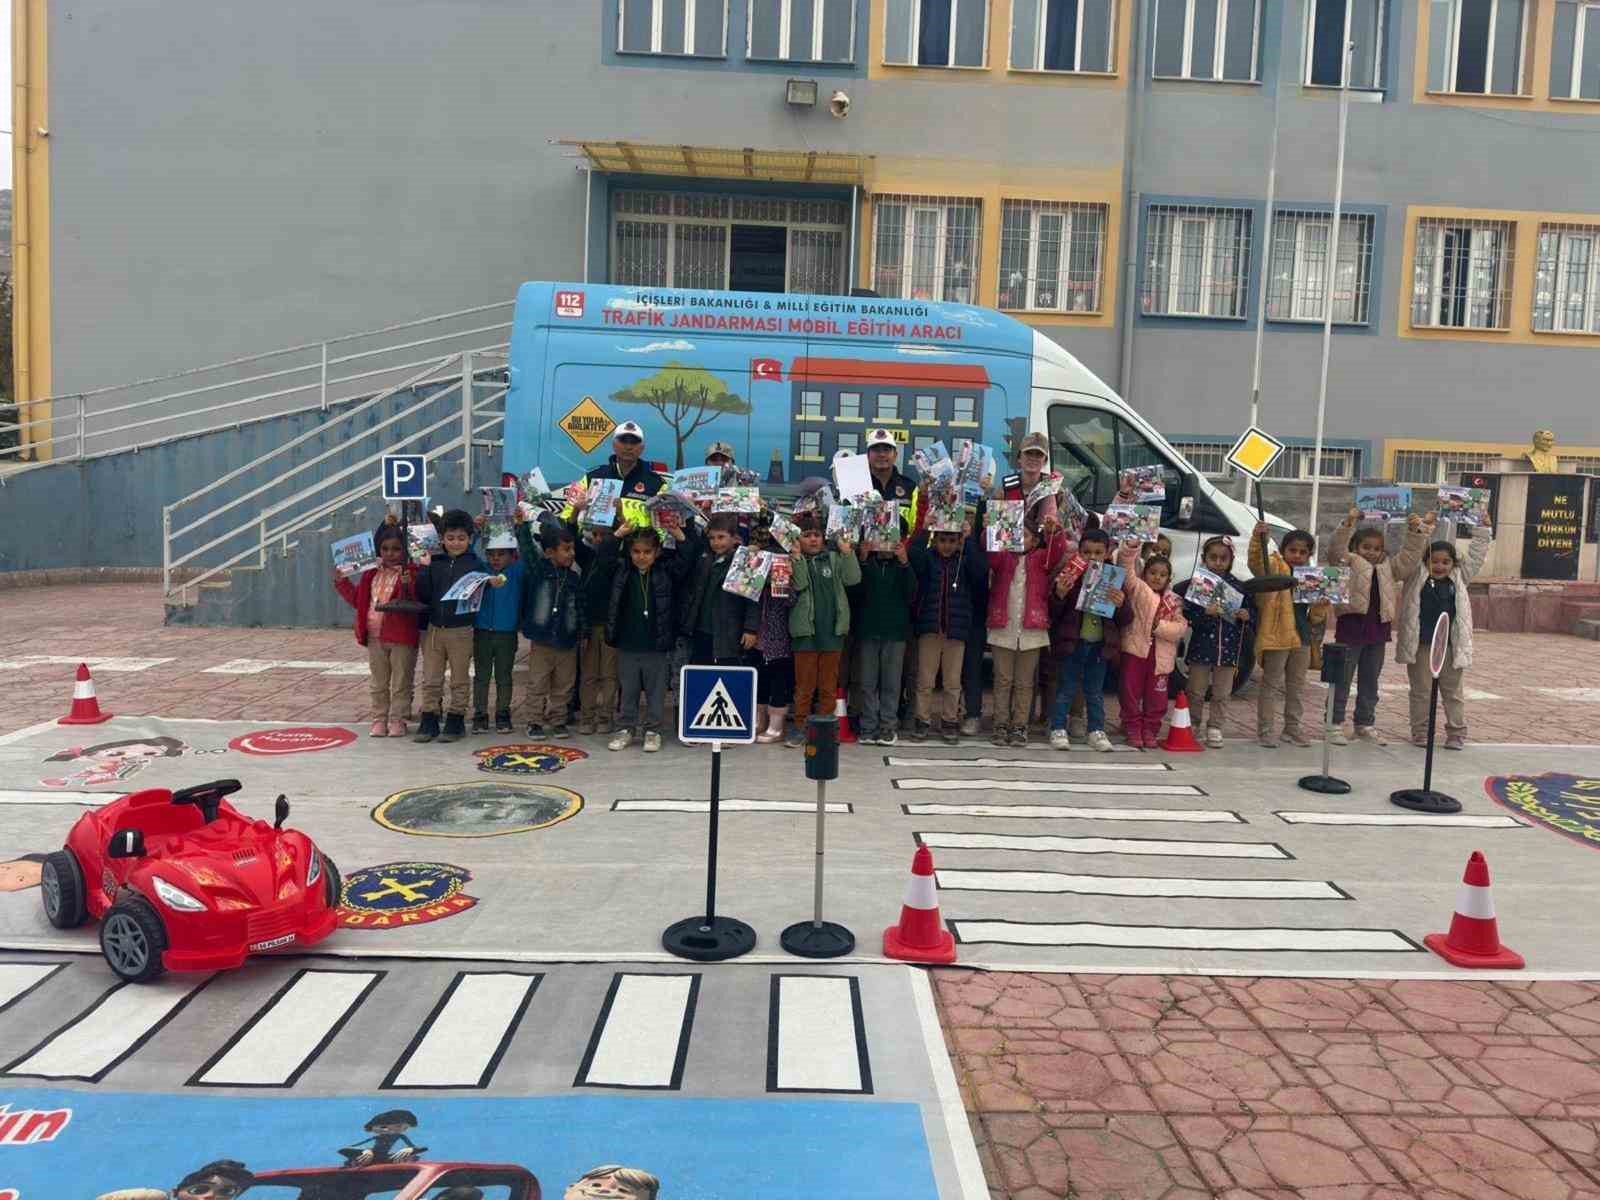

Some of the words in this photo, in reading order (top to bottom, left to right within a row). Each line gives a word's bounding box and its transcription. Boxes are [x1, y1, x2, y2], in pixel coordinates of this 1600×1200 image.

[560, 293, 580, 306] 112
[690, 296, 759, 310] BAKANLIĞI
[763, 301, 771, 310] &
[813, 302, 857, 314] EĞİTİM
[861, 305, 928, 317] BAKANLIĞI
[603, 308, 665, 327] TRAFİK
[672, 313, 782, 332] JANDARMASI
[788, 317, 842, 335] MOBİL
[847, 319, 906, 338] EĞİTİM
[910, 324, 961, 340] ARACI
[393, 460, 415, 494] P
[1554, 496, 1568, 504] NE
[1541, 510, 1575, 518] MUTLU
